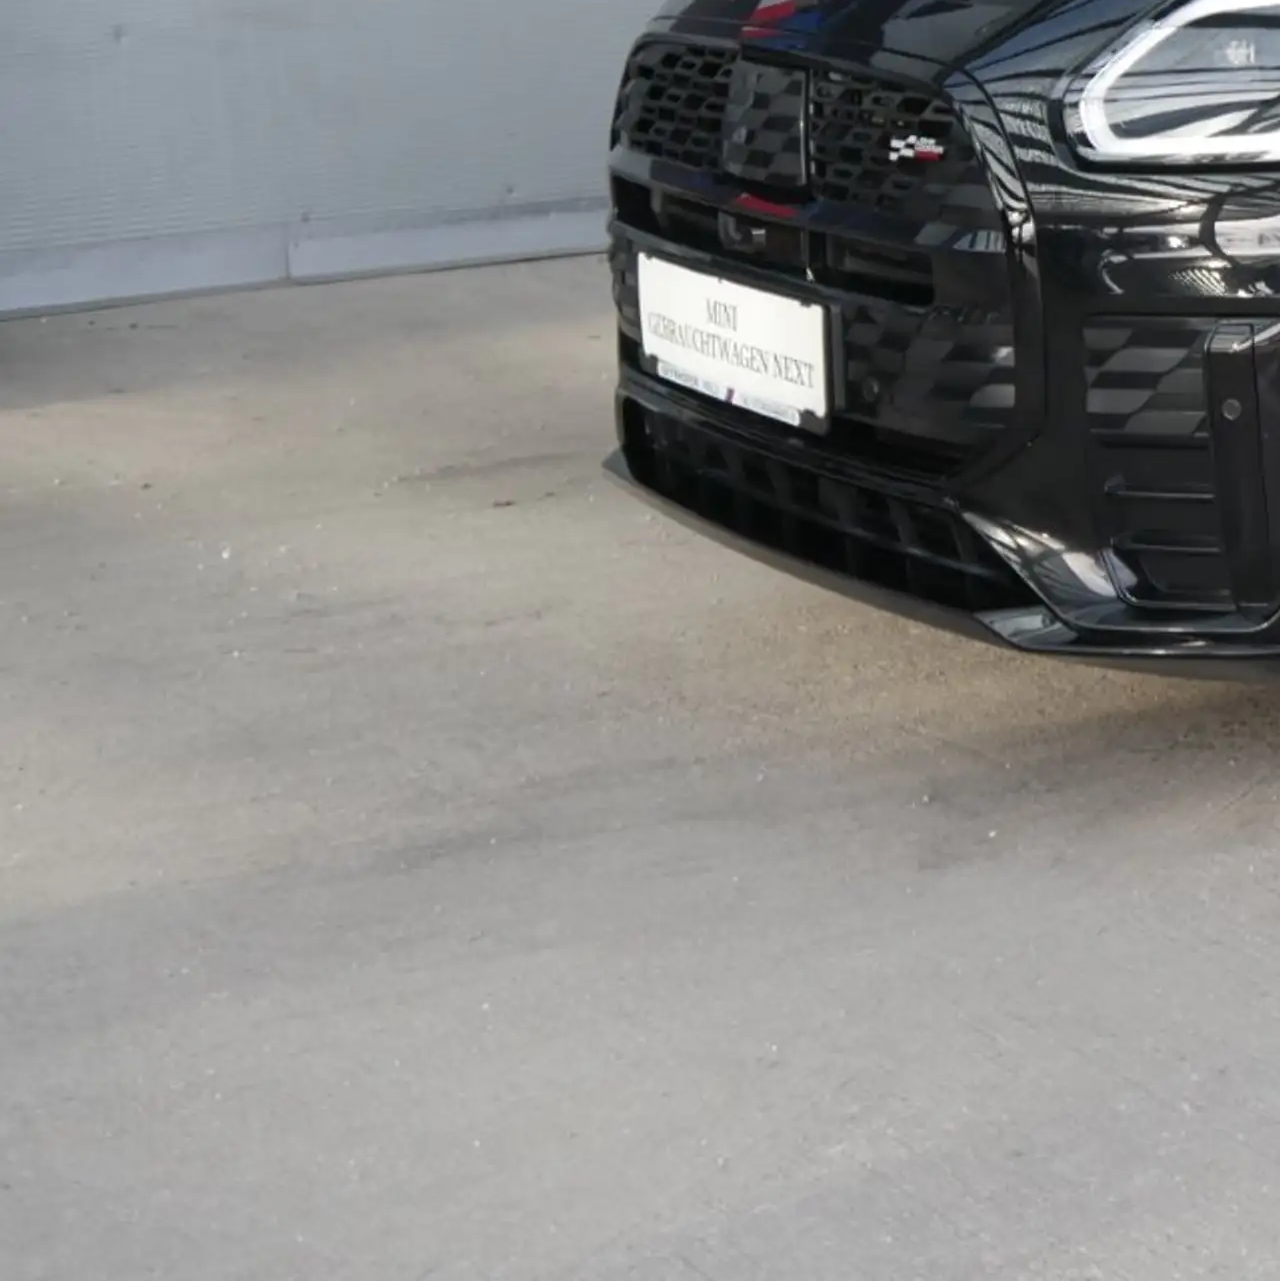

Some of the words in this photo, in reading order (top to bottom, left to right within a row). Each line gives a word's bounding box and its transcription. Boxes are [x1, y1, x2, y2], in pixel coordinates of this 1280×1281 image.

[706, 298, 737, 332] MINI
[648, 312, 770, 375] GEBRAUCHTWAGEN
[773, 353, 815, 388] NEXT
